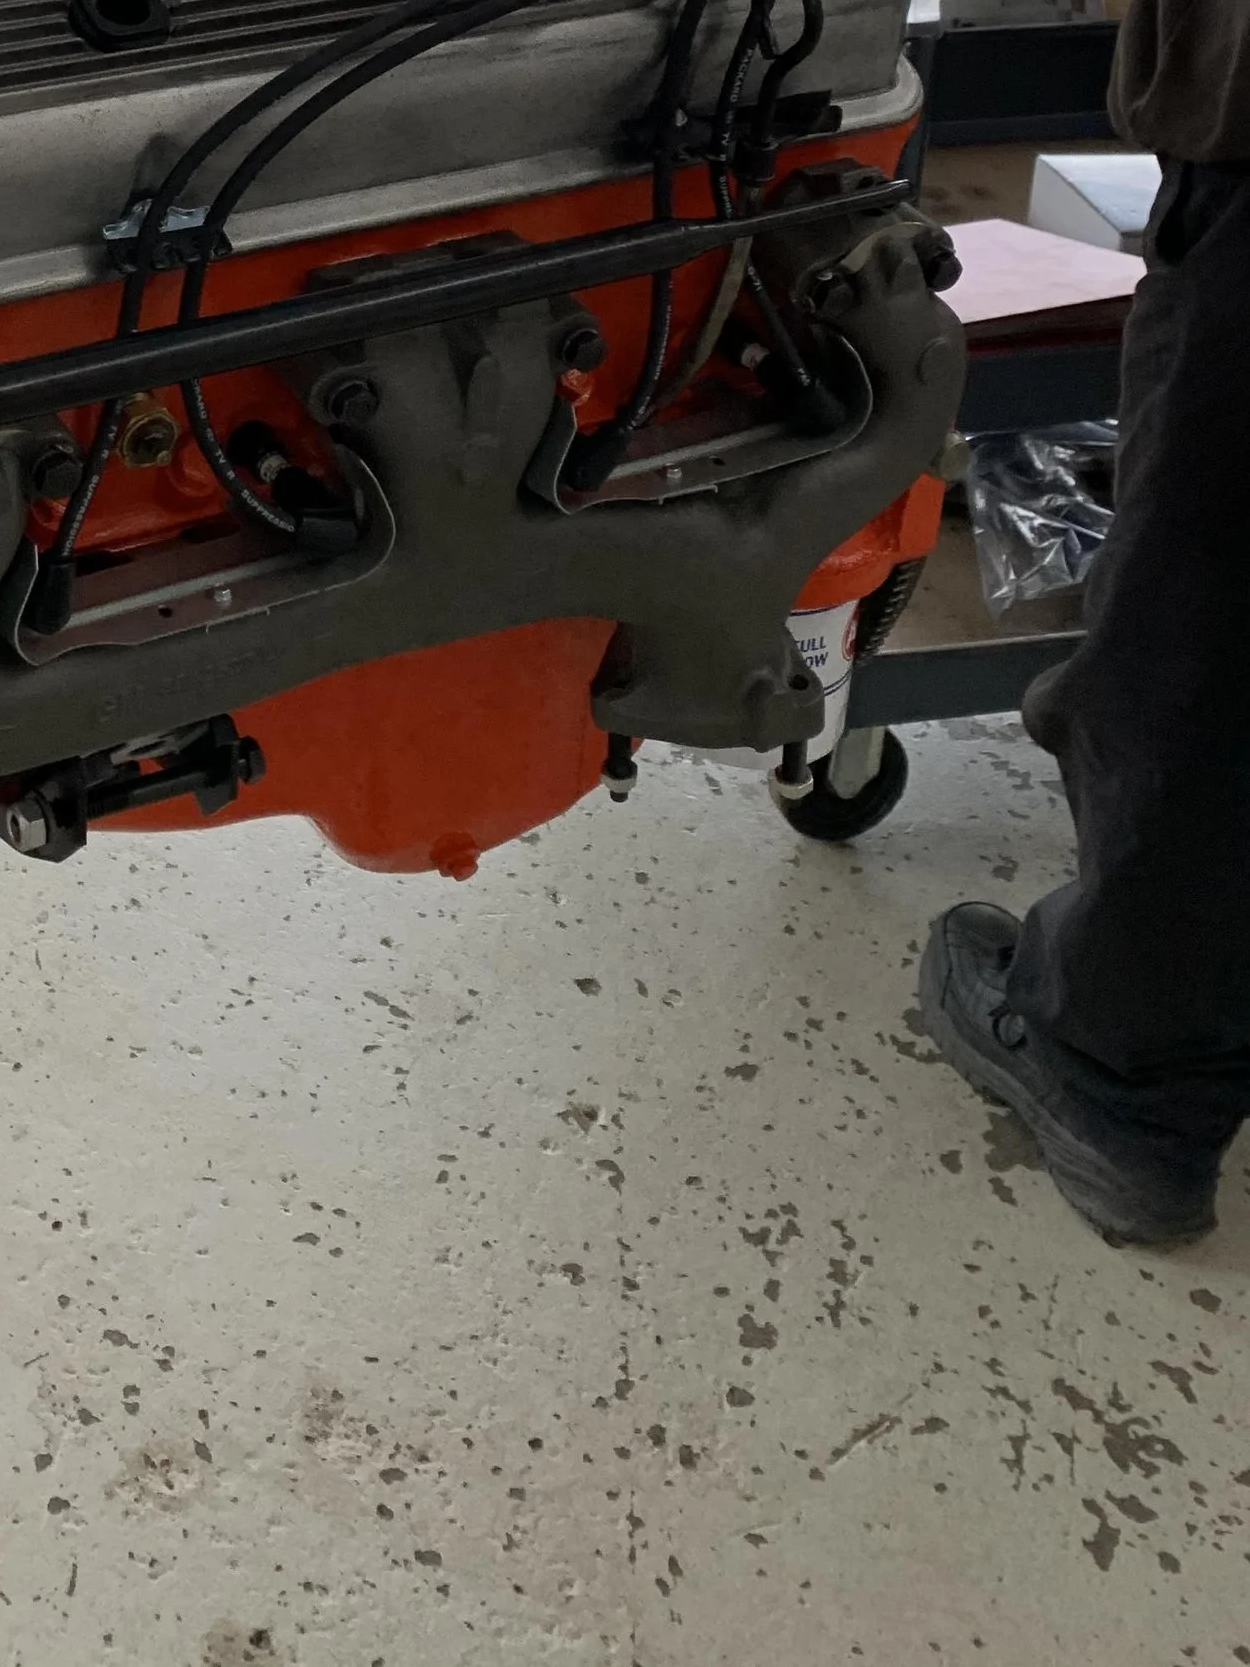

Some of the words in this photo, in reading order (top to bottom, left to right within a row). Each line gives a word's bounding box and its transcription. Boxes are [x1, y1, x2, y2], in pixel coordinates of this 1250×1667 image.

[61, 475, 100, 556] SUPPRESSION
[241, 489, 295, 532] SUPPRESSIO
[794, 636, 827, 653] ULL
[805, 651, 829, 668] OW
